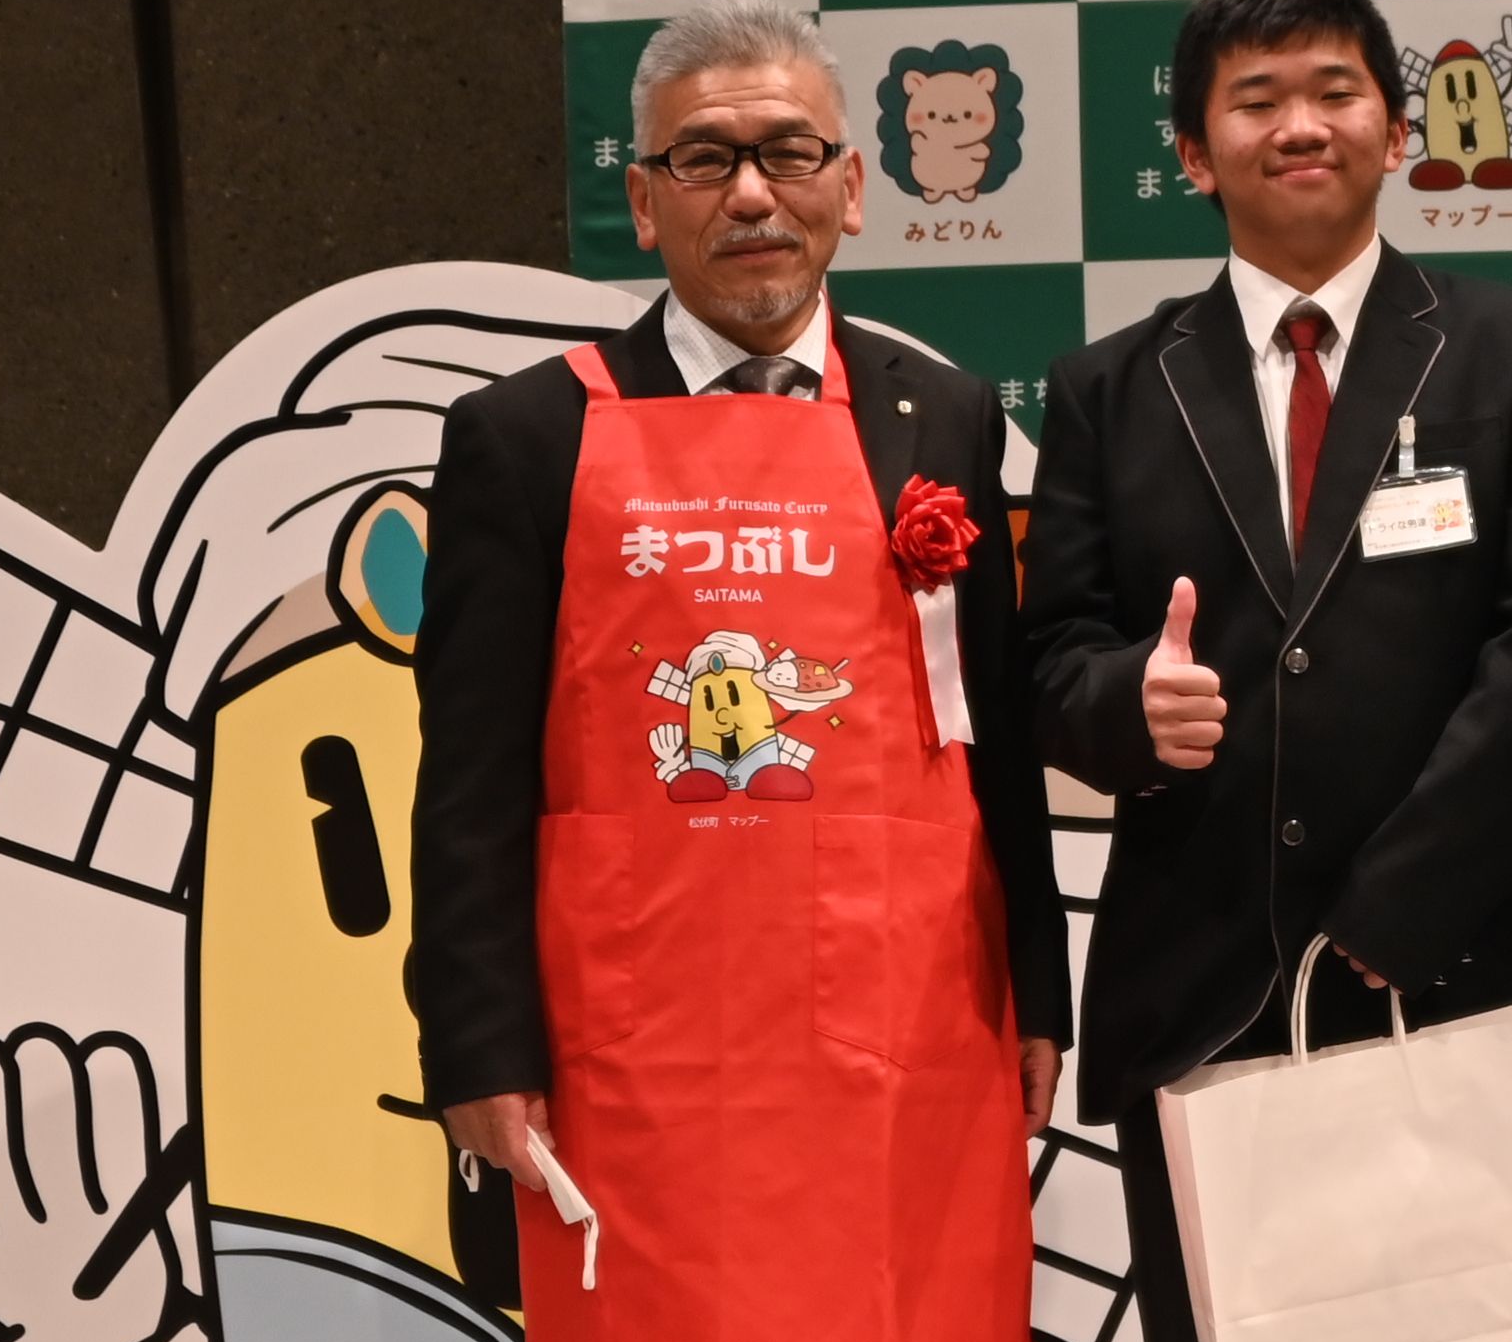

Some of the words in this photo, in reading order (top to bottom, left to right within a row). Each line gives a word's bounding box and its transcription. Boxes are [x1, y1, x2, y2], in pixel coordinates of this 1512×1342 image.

[904, 219, 1003, 243] みどりん
[625, 497, 709, 513] Matsubushi
[713, 496, 781, 513] Furusato
[784, 500, 828, 515] Curry
[621, 524, 835, 577] まつぶし
[694, 588, 763, 603] SAITAMA
